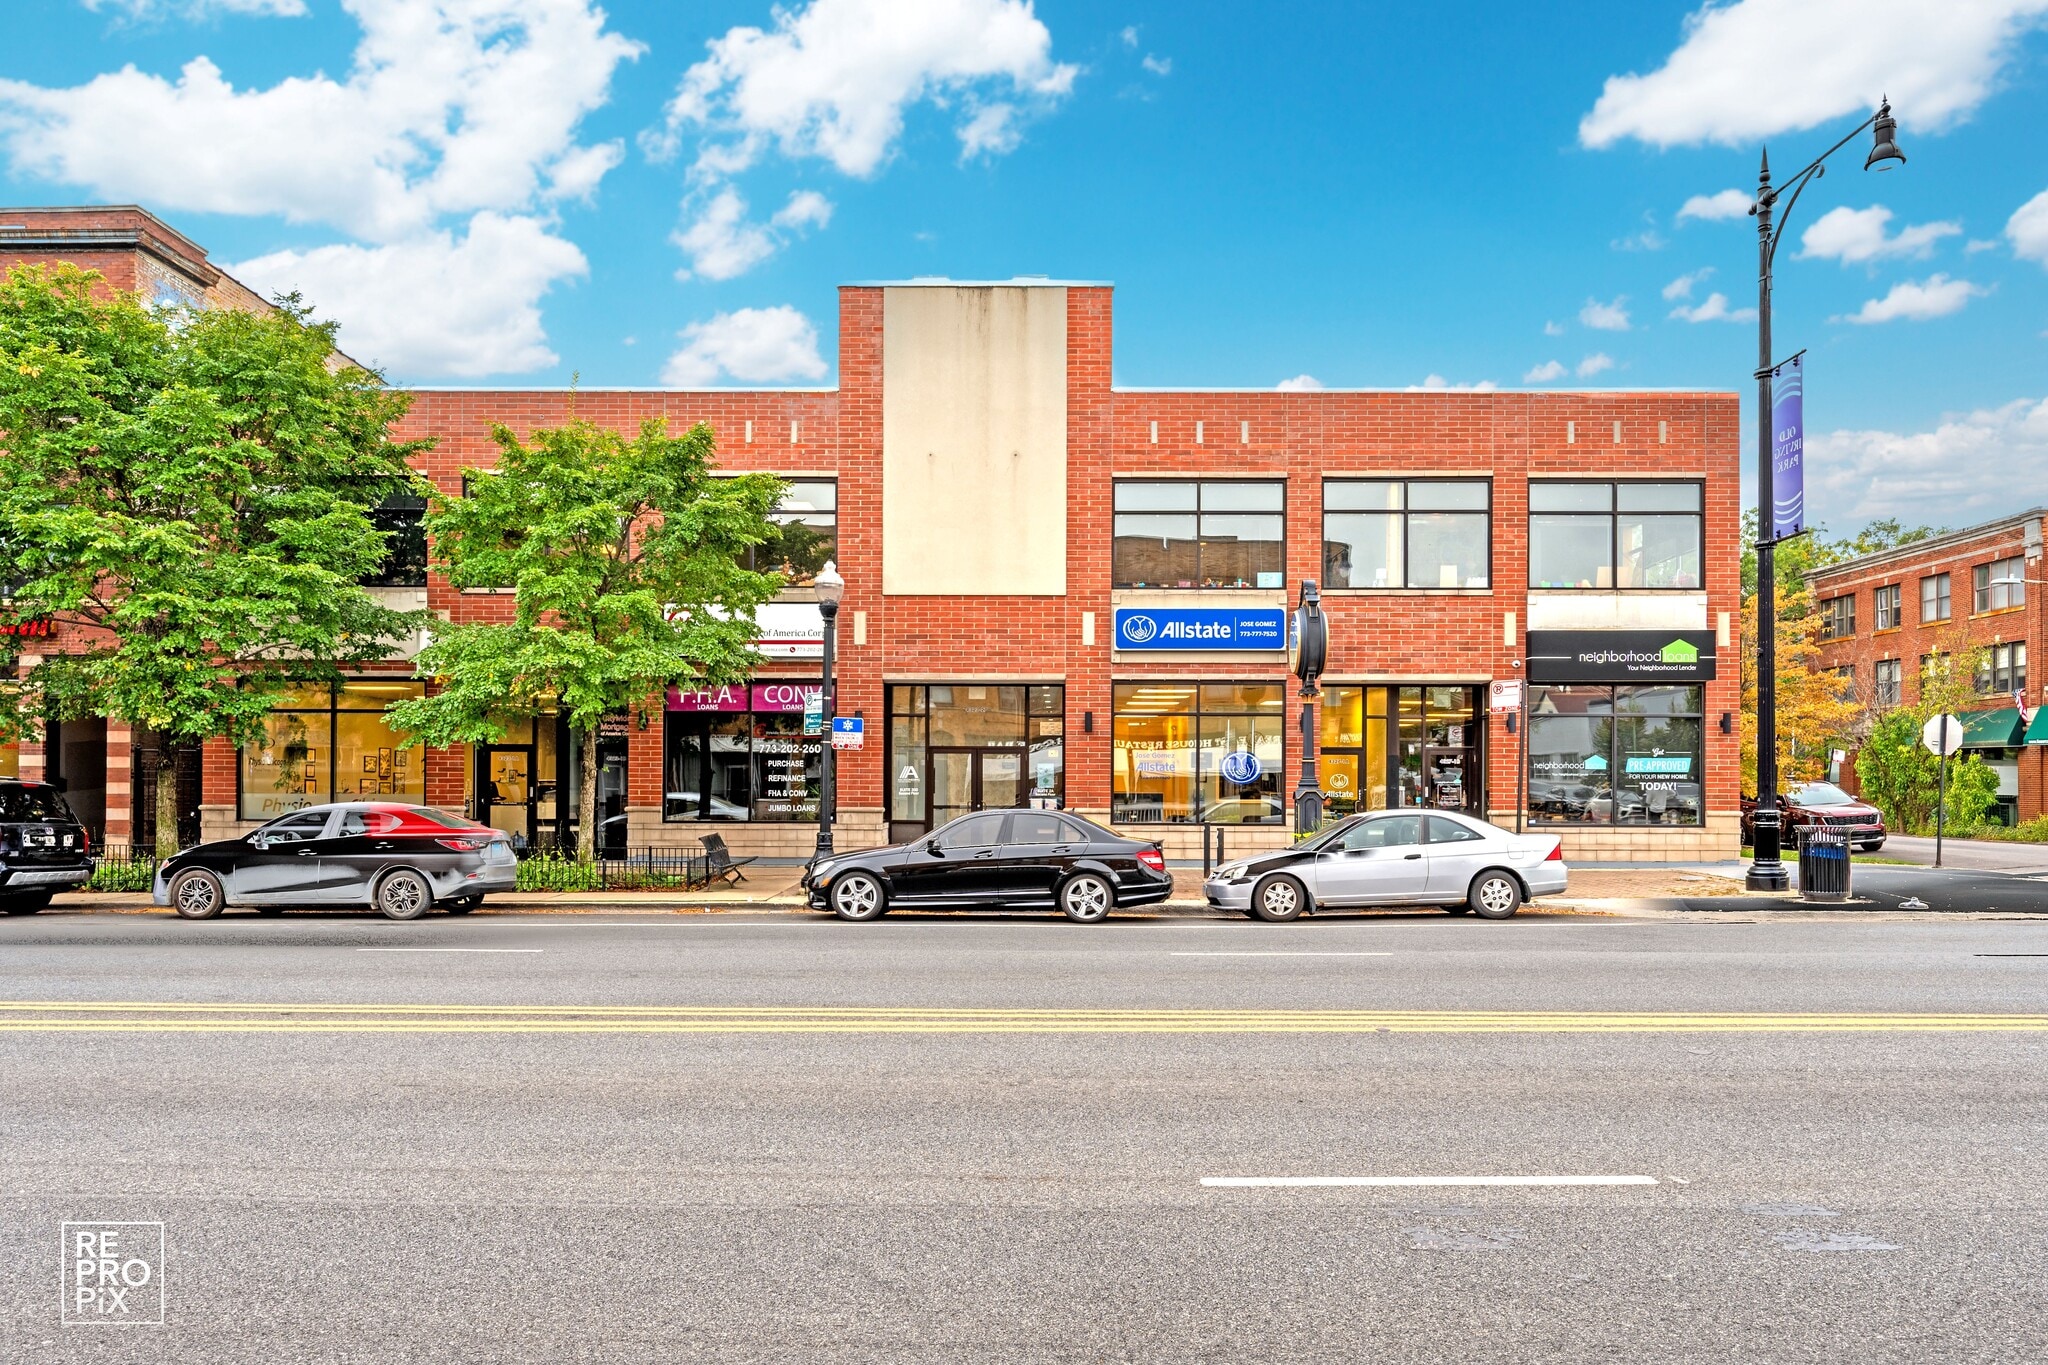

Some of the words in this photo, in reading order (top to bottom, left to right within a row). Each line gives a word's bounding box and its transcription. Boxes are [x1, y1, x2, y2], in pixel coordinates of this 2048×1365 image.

[763, 629, 773, 637] of
[773, 629, 806, 637] America
[1159, 621, 1231, 639] Allstate
[1579, 650, 1662, 664] neighborhood
[1664, 650, 1696, 661] loans
[1640, 664, 1678, 672] Neighborhood
[697, 703, 719, 711] LOANS
[782, 703, 804, 711] LOANS
[760, 744, 822, 753] 773-202-260
[1651, 748, 1665, 757] Get
[1151, 752, 1175, 760] Gomez
[1136, 762, 1175, 771] Allstate
[1533, 761, 1584, 770] neighborhood
[1629, 760, 1688, 771] PRE-APPROVED
[1639, 782, 1677, 791] TODAY!
[1325, 790, 1354, 798] Allstate
